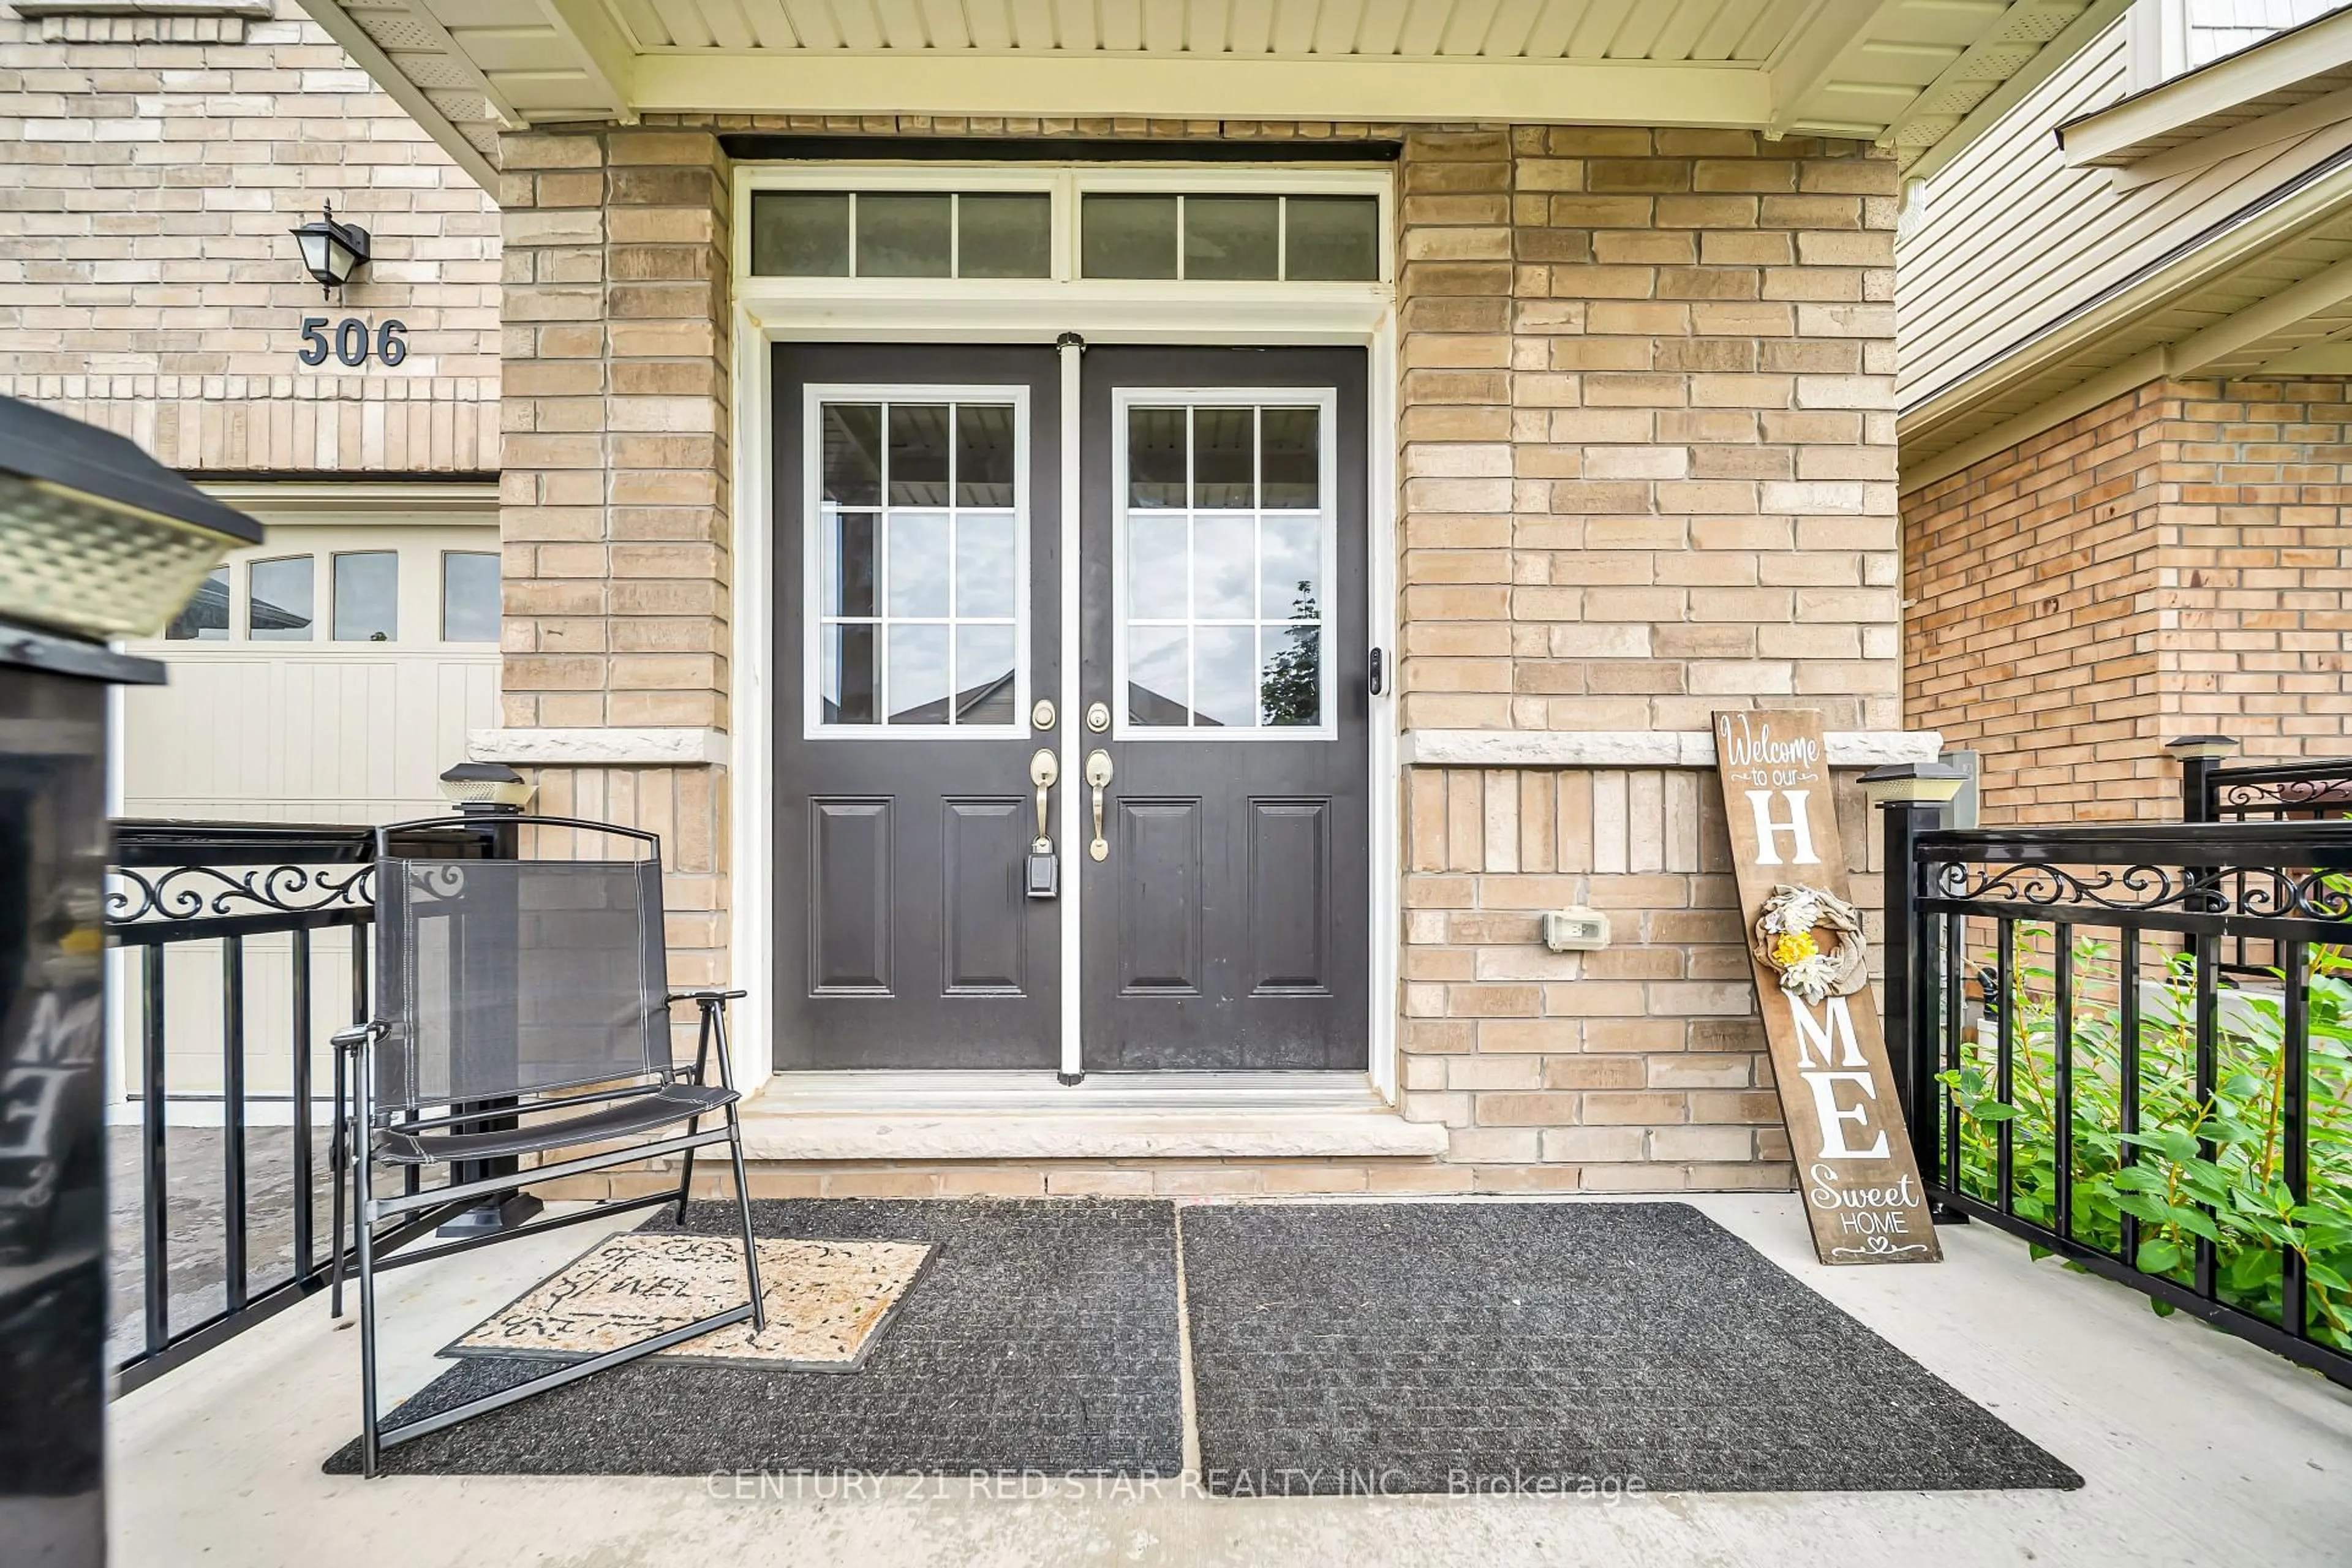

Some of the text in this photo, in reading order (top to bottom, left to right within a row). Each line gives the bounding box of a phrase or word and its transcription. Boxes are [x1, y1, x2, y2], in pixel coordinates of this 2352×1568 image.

[299, 318, 407, 366] 506
[1720, 714, 1820, 769] Welcome
[1752, 767, 1798, 786] to our
[1811, 1164, 1920, 1209] Sweet
[1841, 1212, 1909, 1234] HOME
